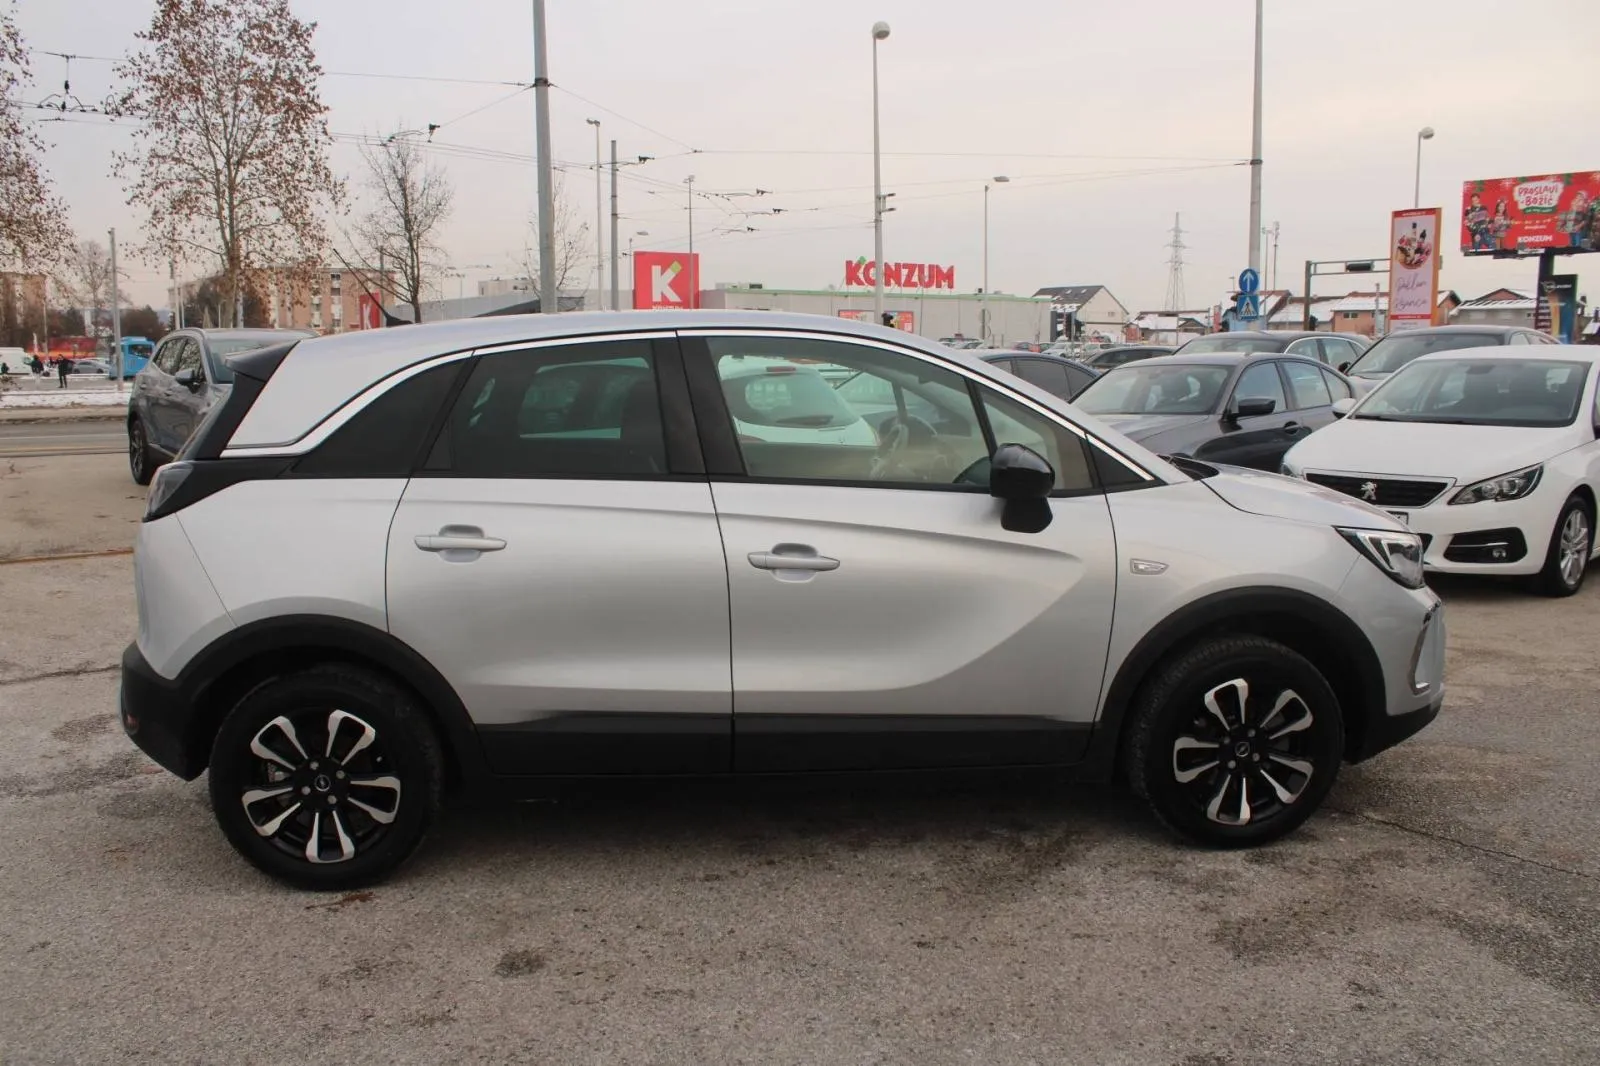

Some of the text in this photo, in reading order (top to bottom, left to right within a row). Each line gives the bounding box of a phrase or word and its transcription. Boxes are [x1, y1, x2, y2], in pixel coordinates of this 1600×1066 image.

[1517, 235, 1553, 243] KONZUM
[652, 260, 682, 302] K
[845, 256, 955, 289] KONZUM
